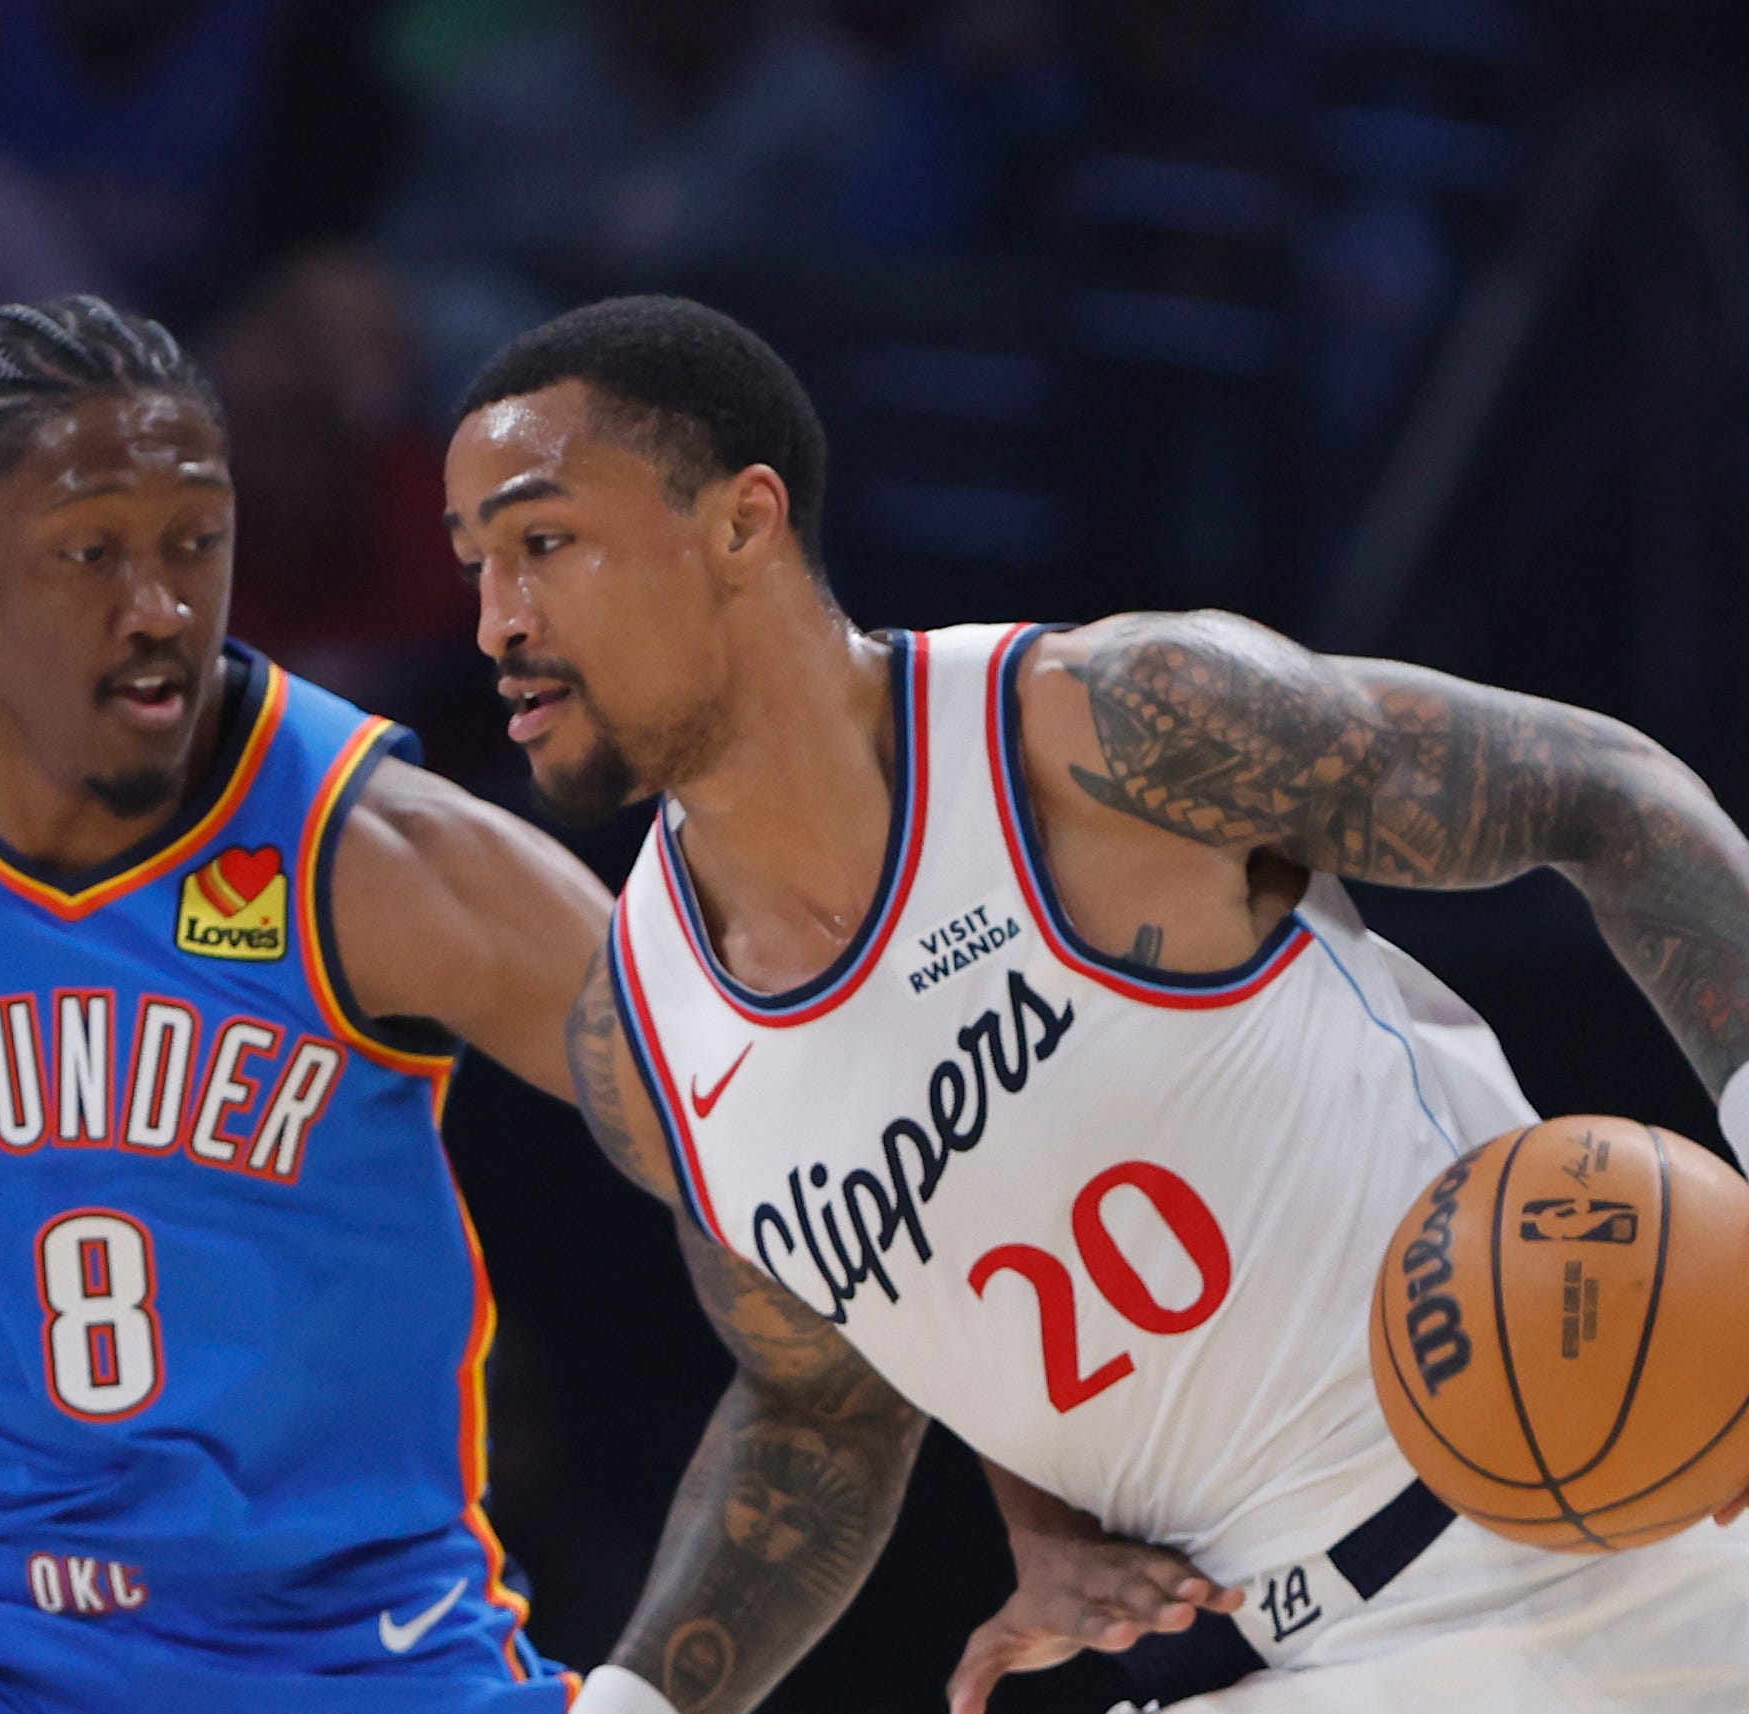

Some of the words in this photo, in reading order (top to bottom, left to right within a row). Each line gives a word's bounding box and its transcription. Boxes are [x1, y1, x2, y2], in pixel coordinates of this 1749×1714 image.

[909, 917, 1021, 994] RWANDA
[919, 904, 990, 955] VISIT
[753, 968, 1075, 1325] Clippers
[36, 1206, 164, 1423] 8
[967, 1160, 1231, 1414] 20
[1260, 1565, 1322, 1642] LA
